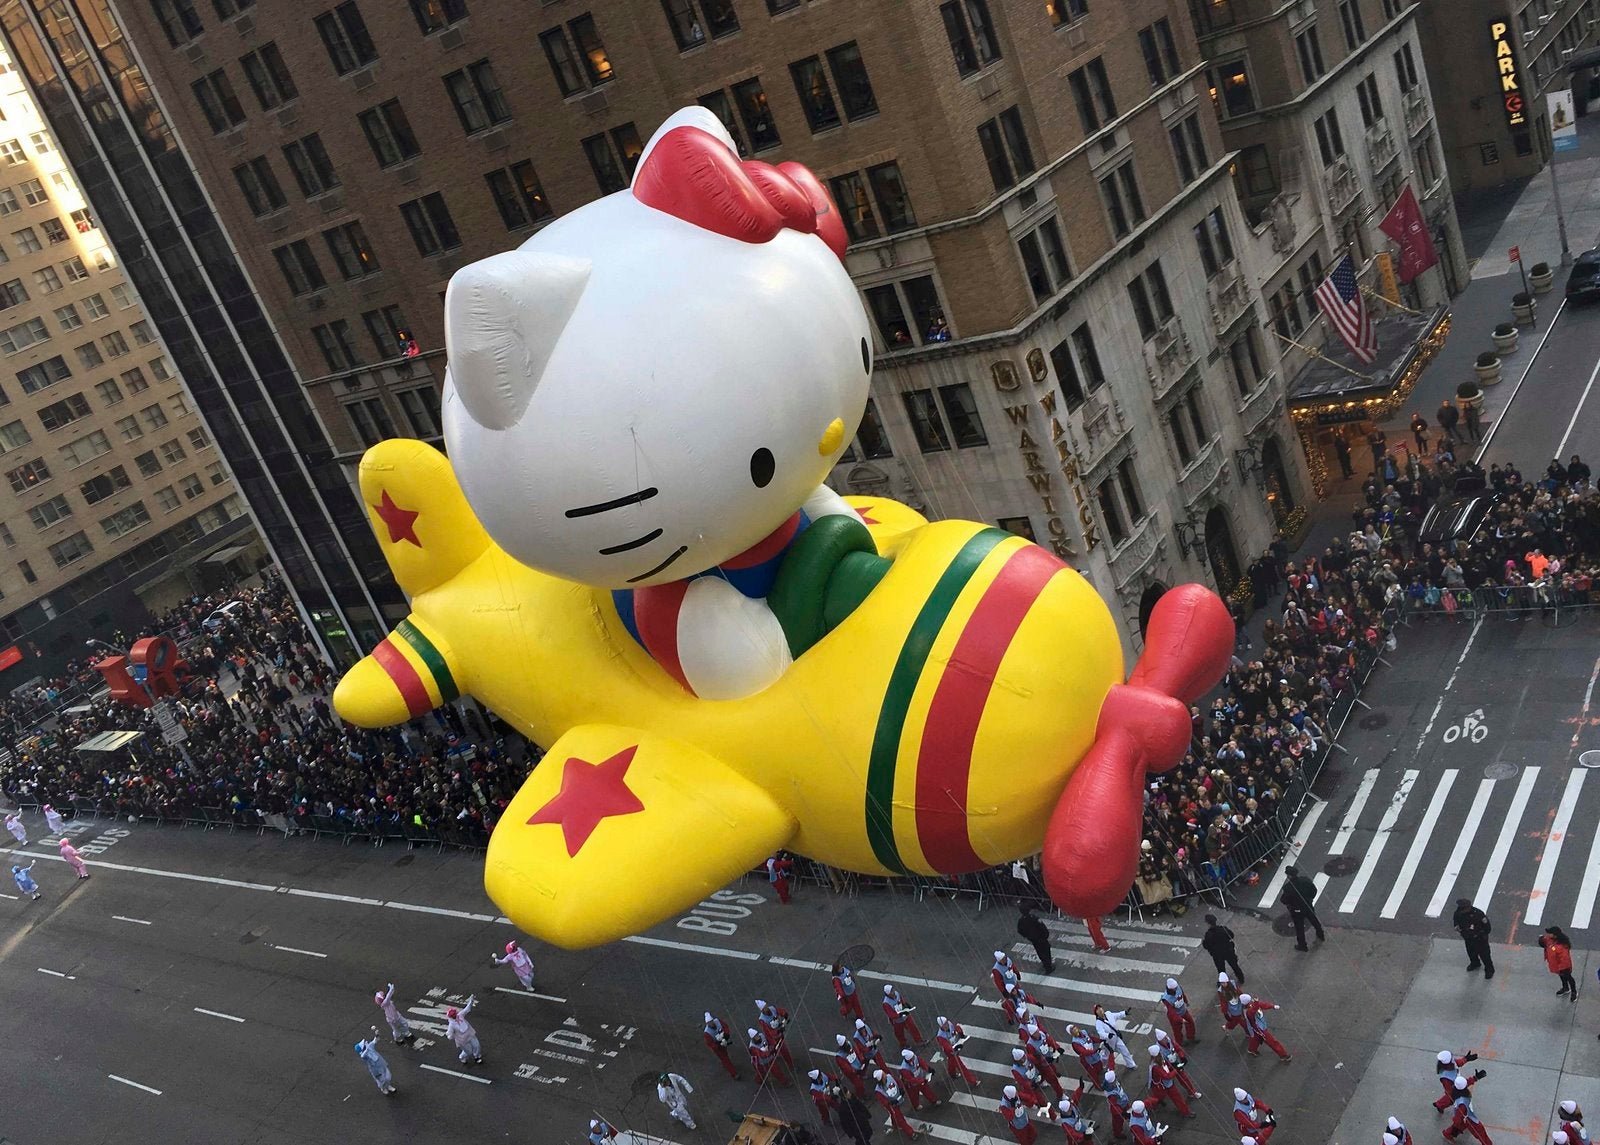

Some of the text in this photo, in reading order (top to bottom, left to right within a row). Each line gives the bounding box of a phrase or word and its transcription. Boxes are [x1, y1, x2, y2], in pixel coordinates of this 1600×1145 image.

[1491, 22, 1519, 92] PARK
[1003, 404, 1078, 558] WARWICK
[1039, 389, 1101, 552] WARWICK
[77, 828, 131, 854] BUS
[676, 889, 768, 936] BUS
